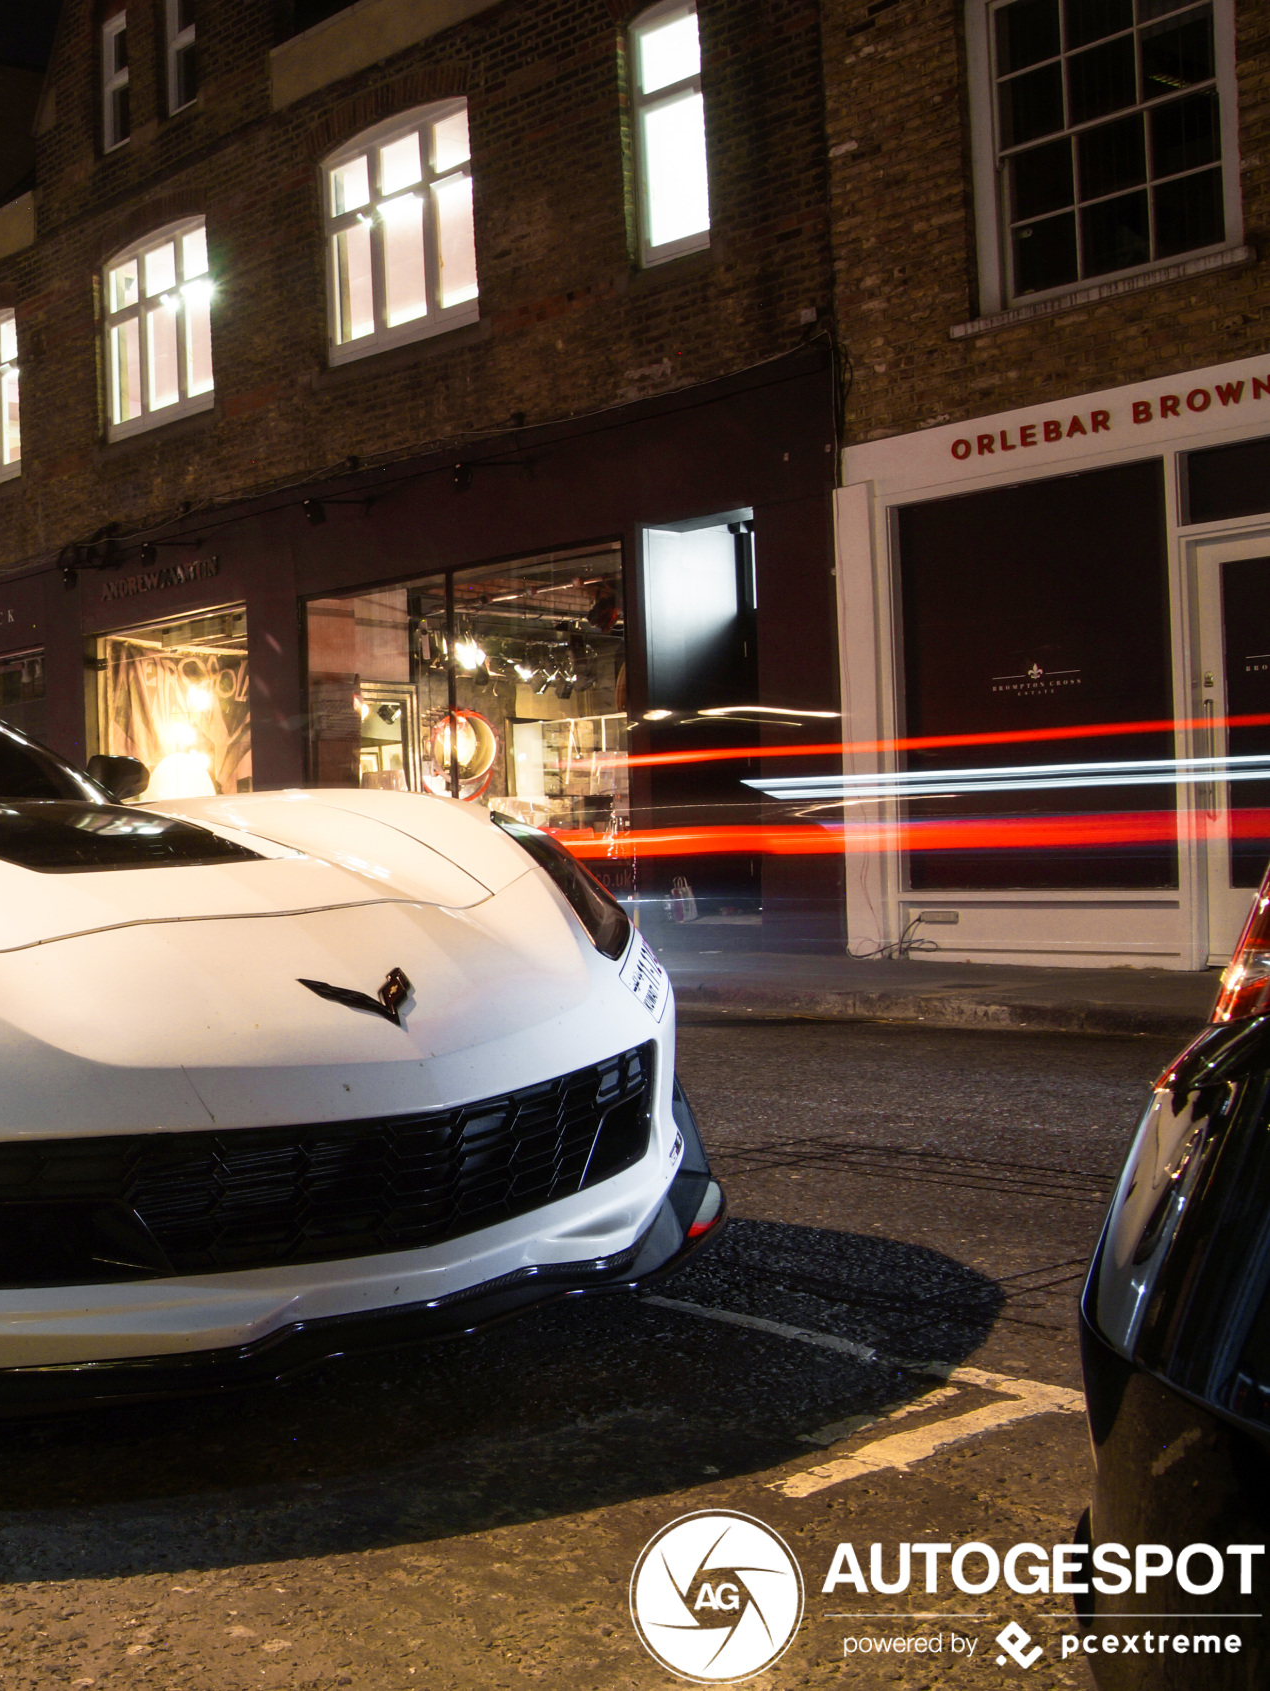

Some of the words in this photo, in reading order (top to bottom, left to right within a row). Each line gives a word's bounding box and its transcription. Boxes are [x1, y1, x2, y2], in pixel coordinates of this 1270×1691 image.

[951, 410, 1111, 460] ORLEBAR
[1132, 374, 1270, 425] BROWN
[101, 573, 159, 602] ANDREW
[157, 556, 218, 588] MARTIN
[992, 682, 1045, 692] BROMPTON
[1049, 679, 1082, 687] CROSS
[1018, 689, 1055, 697] ESTATE
